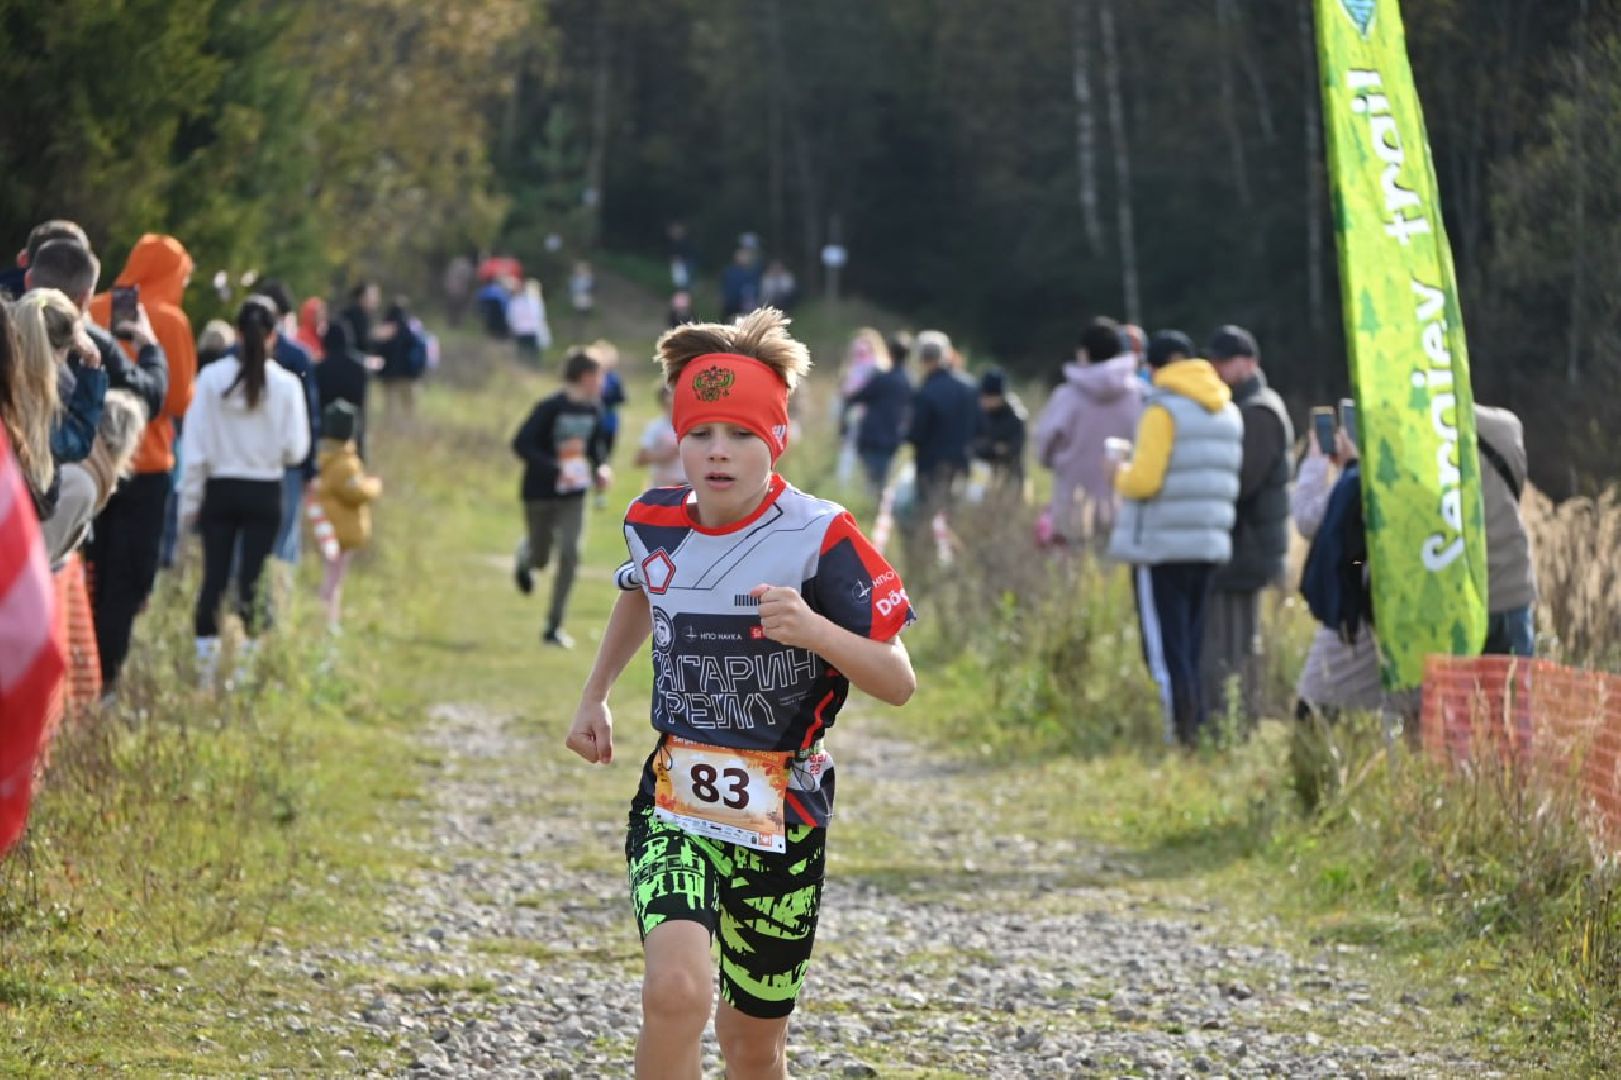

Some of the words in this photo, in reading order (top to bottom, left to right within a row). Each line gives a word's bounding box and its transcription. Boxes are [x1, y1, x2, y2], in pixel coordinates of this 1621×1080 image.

[1347, 69, 1431, 245] trail
[653, 649, 816, 693] АГАРИН
[690, 763, 750, 810] 83
